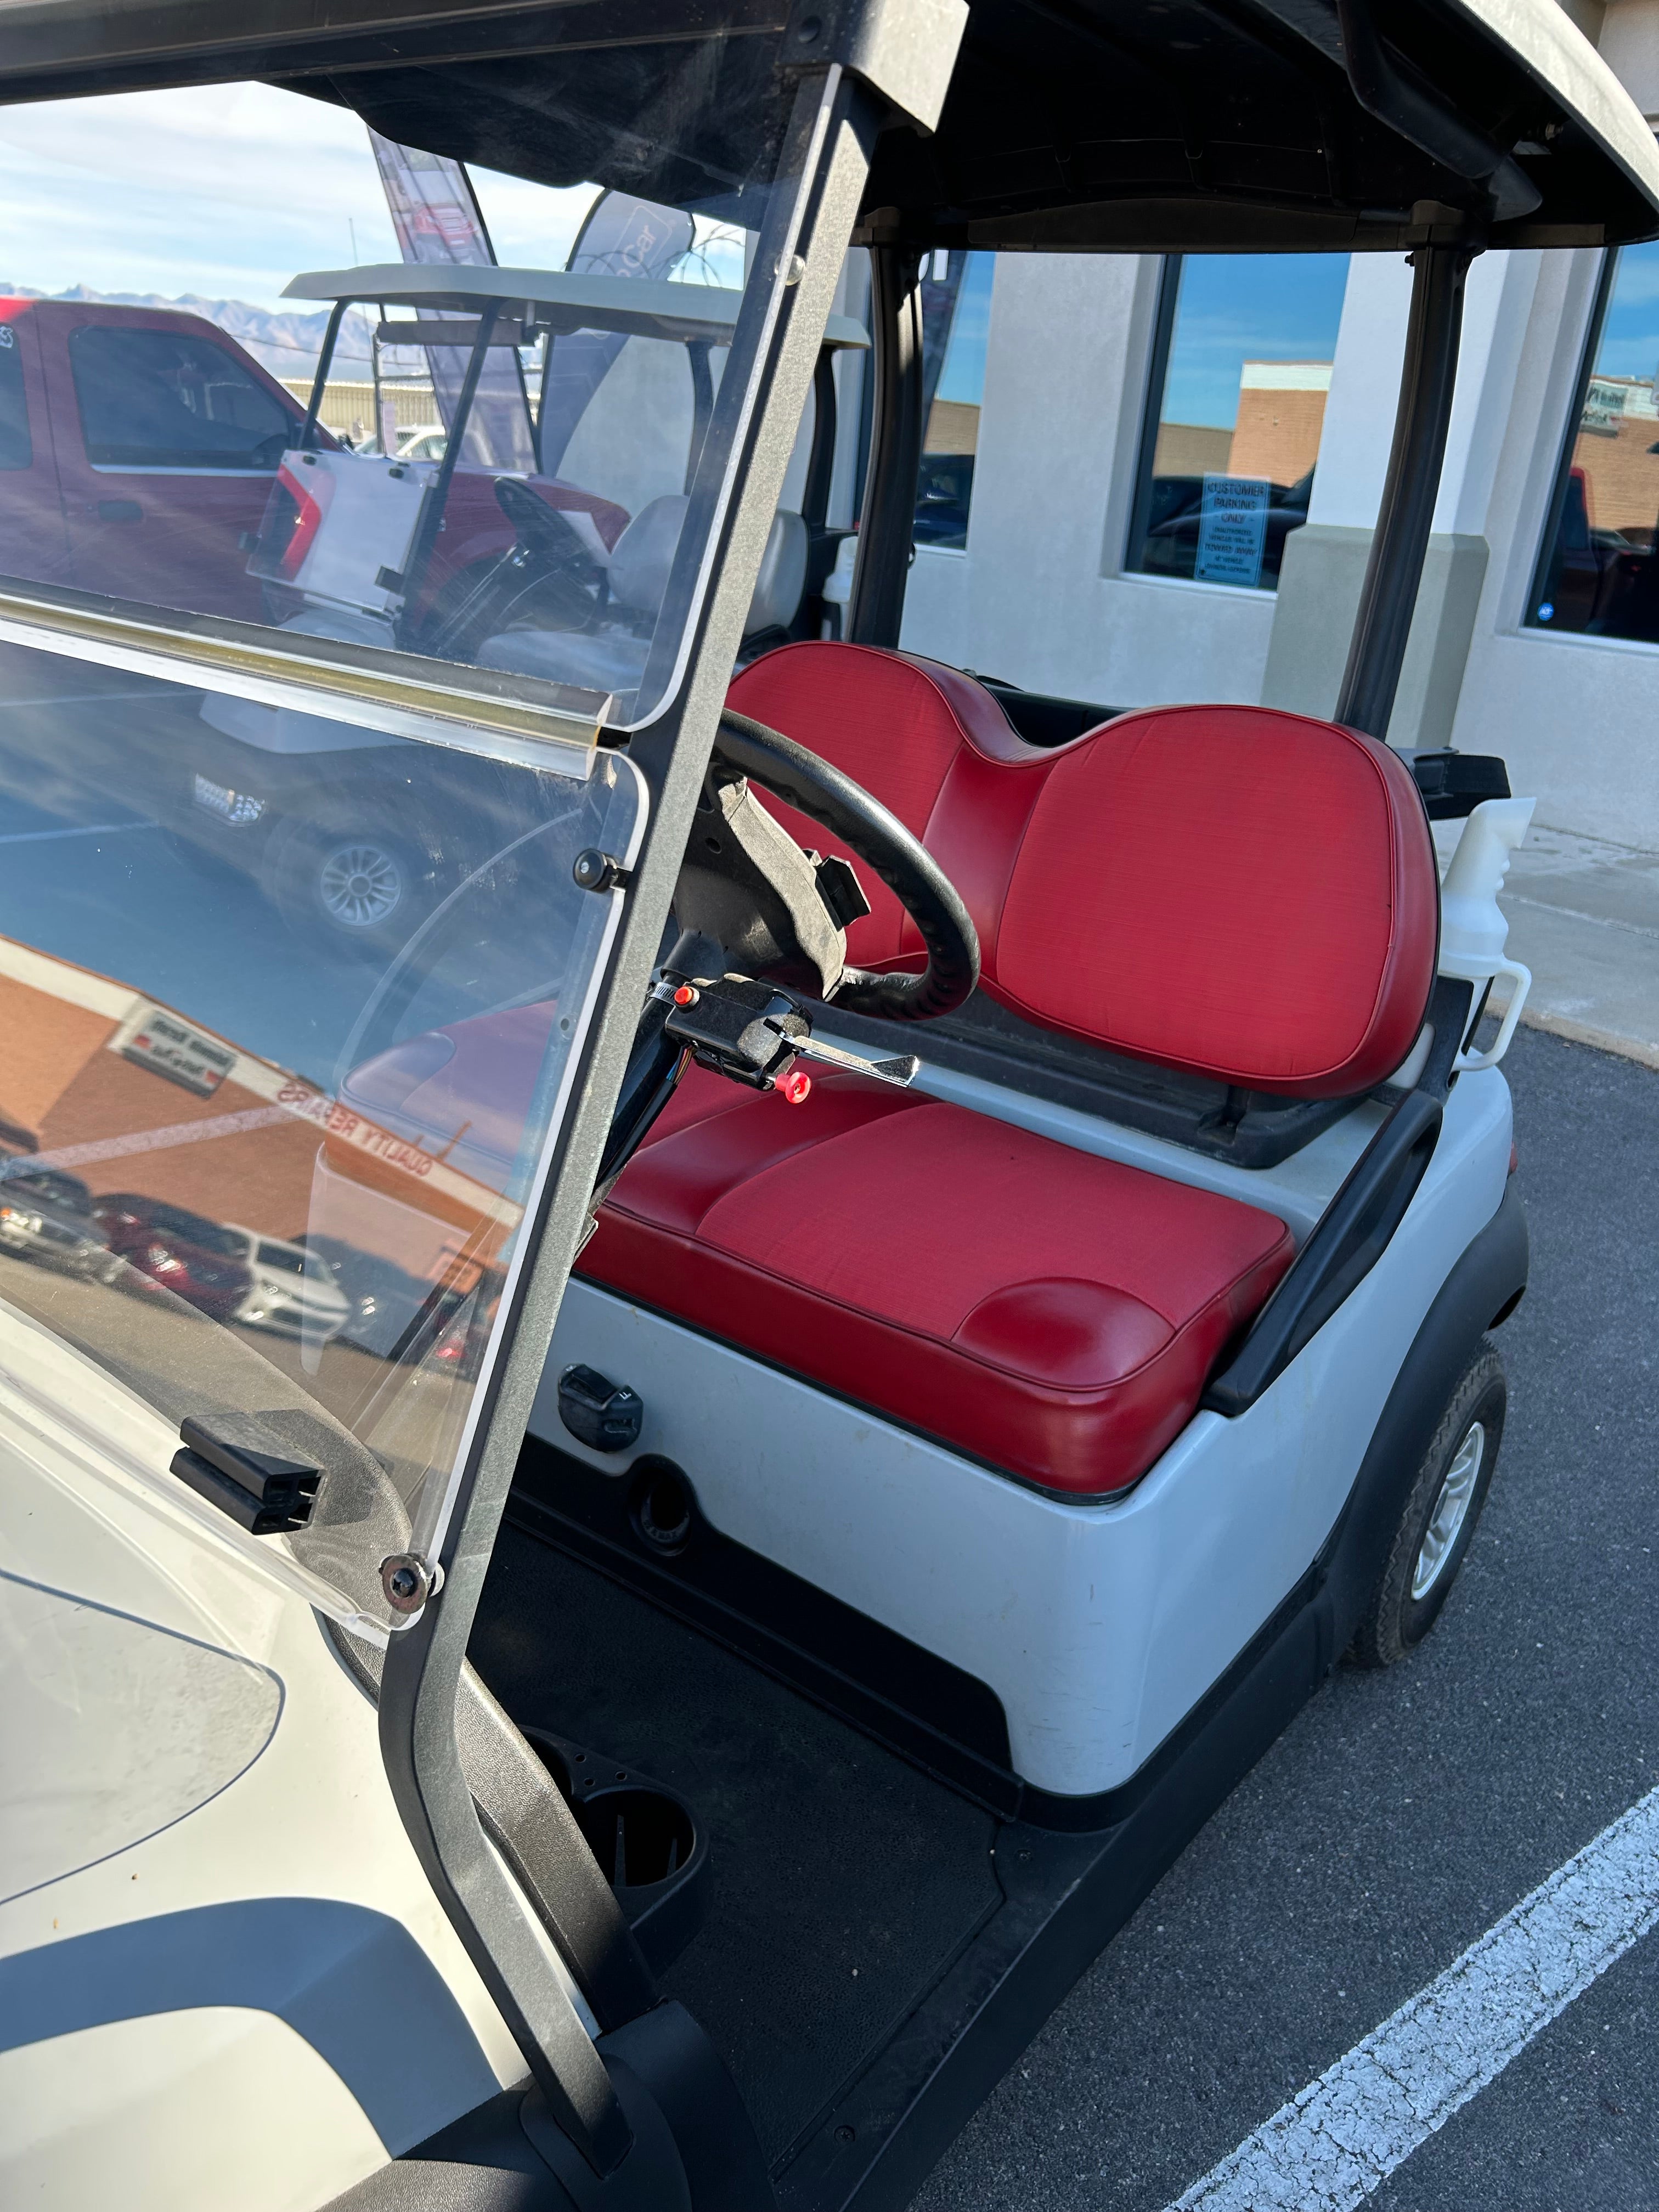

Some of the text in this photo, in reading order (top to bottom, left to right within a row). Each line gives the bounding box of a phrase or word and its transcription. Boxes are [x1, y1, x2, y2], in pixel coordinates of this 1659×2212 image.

[621, 224, 657, 268] Car
[1207, 482, 1265, 497] CUSTOMER
[1214, 496, 1256, 511] PARKING
[1221, 513, 1247, 524] ONLY
[619, 1392, 632, 1401] F
